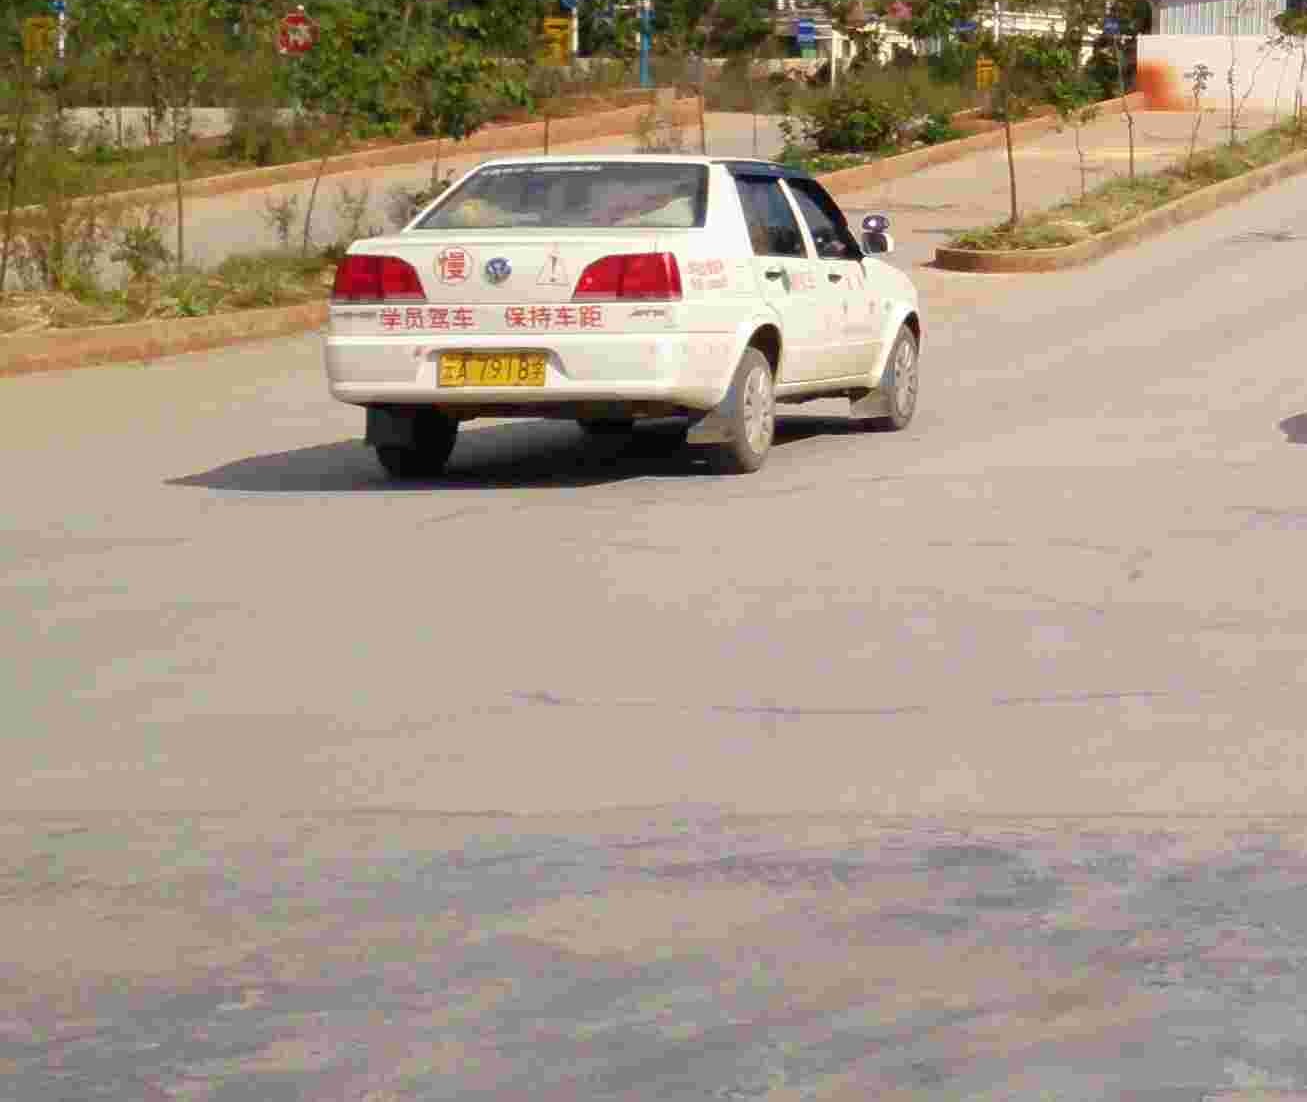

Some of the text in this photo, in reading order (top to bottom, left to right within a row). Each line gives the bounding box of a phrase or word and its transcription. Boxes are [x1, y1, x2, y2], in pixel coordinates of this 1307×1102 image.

[380, 306, 603, 329] 学员驾车 保持车距
